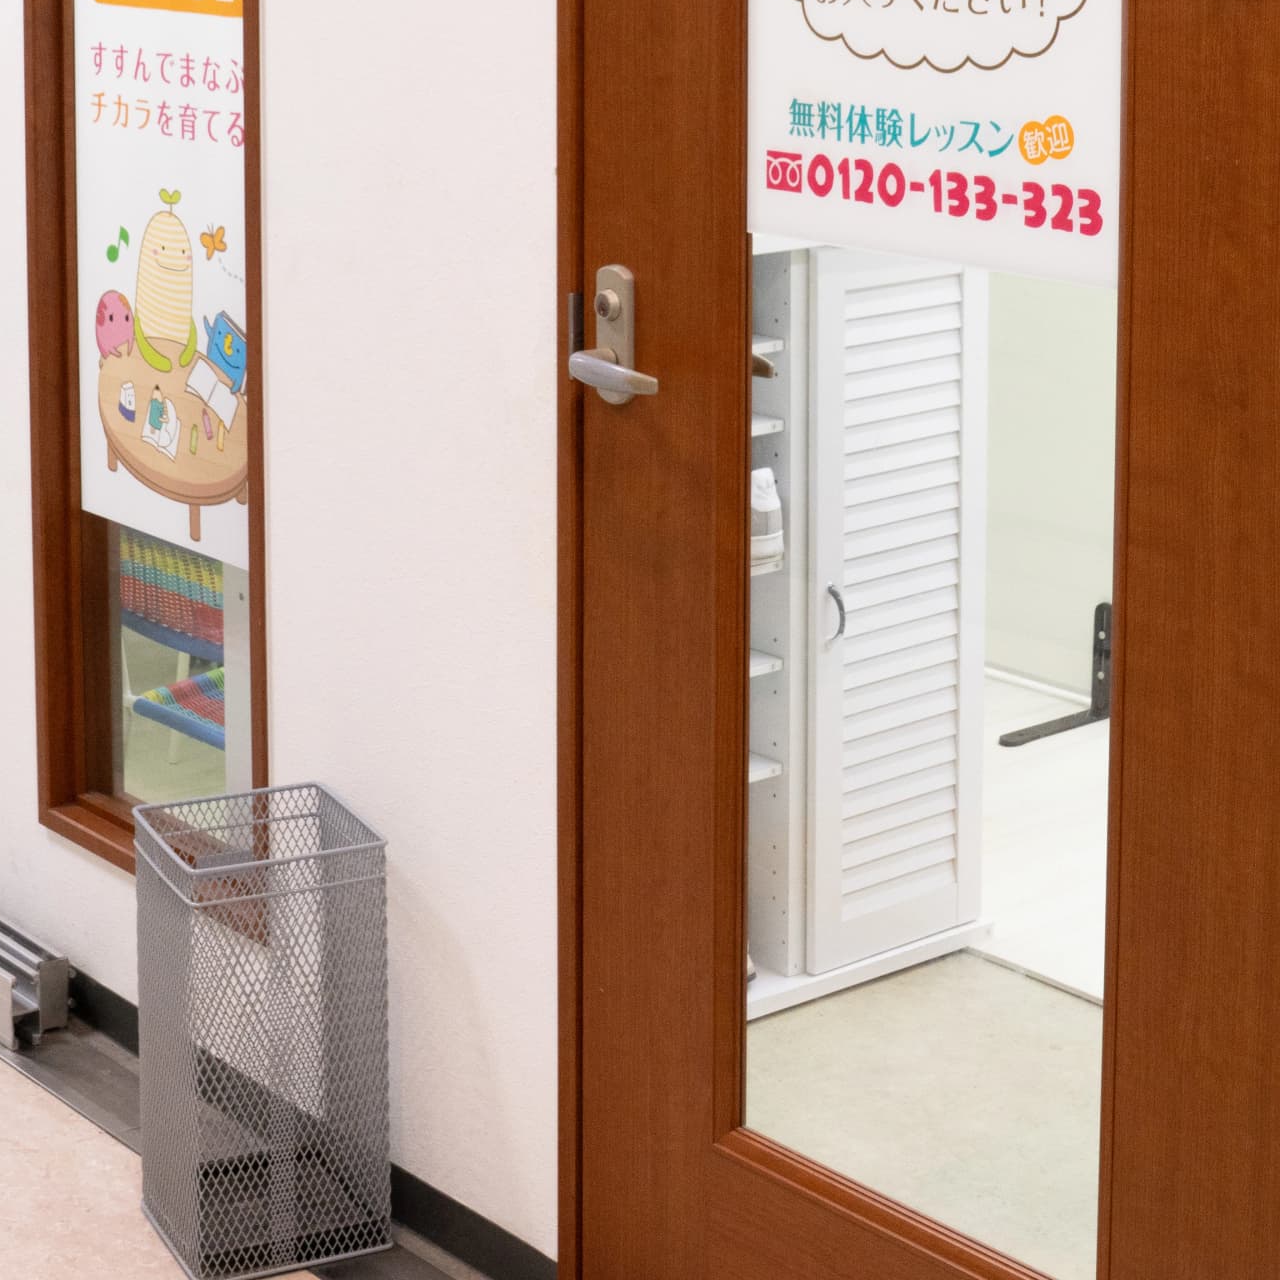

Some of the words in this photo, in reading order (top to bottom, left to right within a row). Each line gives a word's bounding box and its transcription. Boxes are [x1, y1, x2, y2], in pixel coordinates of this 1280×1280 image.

[90, 91, 245, 148] チカラを育てる
[787, 97, 1015, 159] 無料体験レッスン
[1022, 120, 1073, 162] 歓迎
[806, 156, 1104, 237] 0120-133-323
